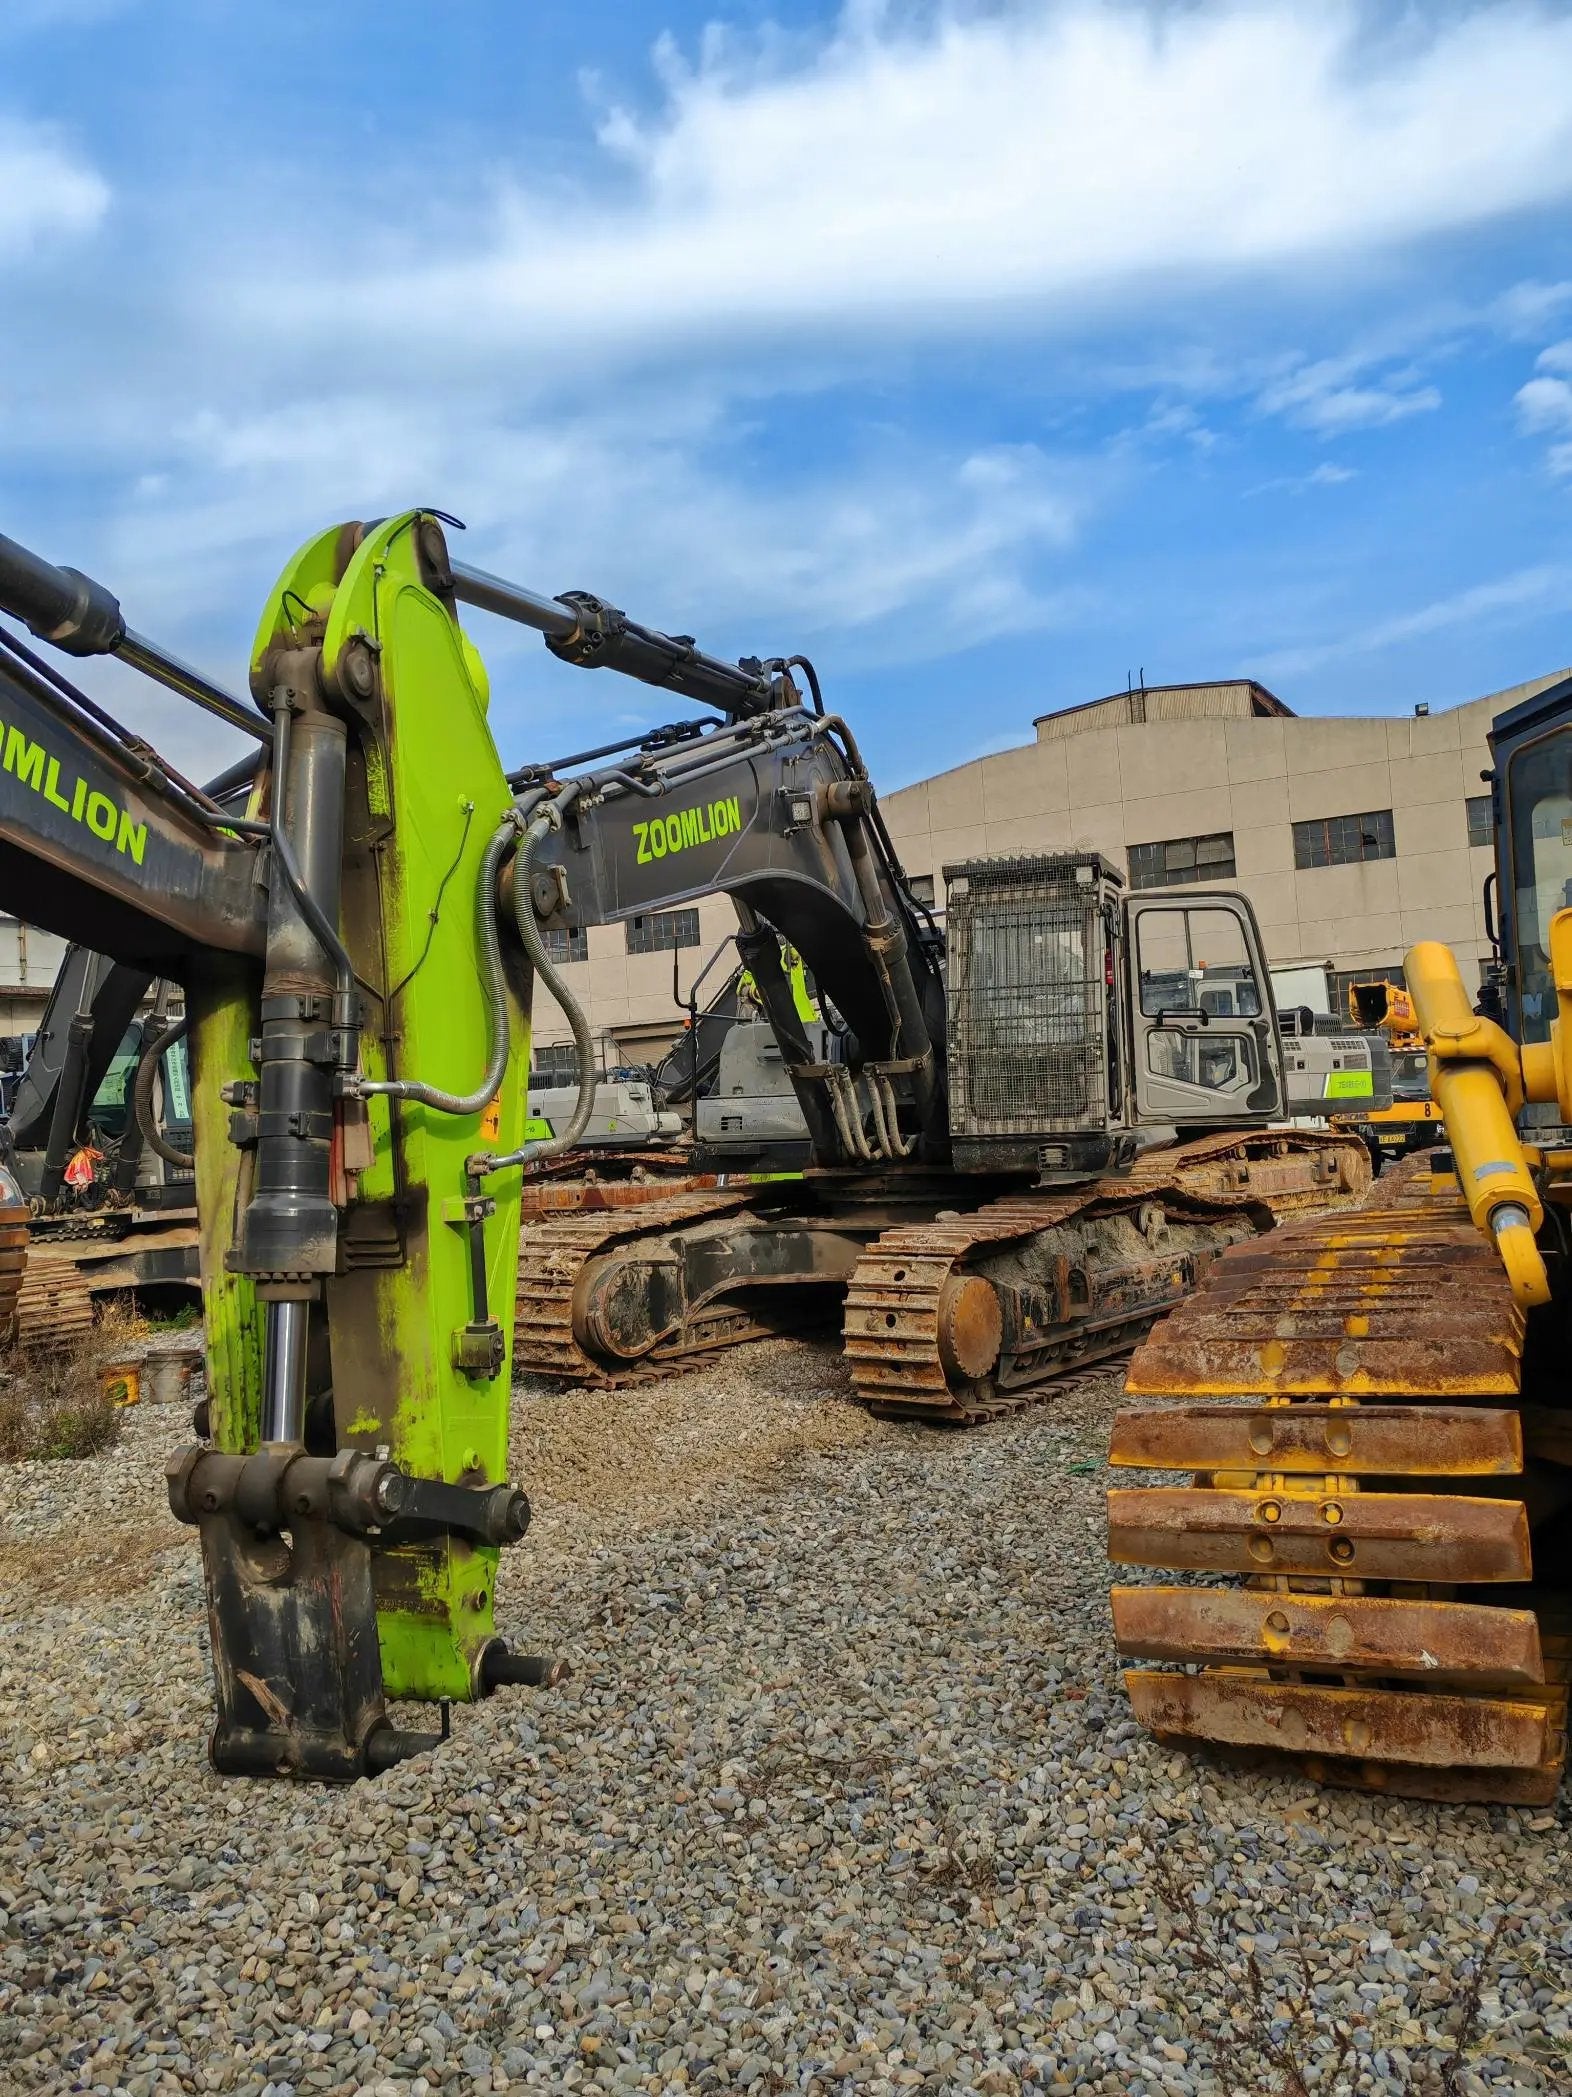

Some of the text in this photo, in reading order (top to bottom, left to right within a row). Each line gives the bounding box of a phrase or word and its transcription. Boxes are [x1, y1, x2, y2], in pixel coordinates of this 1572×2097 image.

[0, 720, 148, 866] MLION
[632, 796, 741, 865] ZOOMLION
[1424, 1102, 1432, 1118] 8
